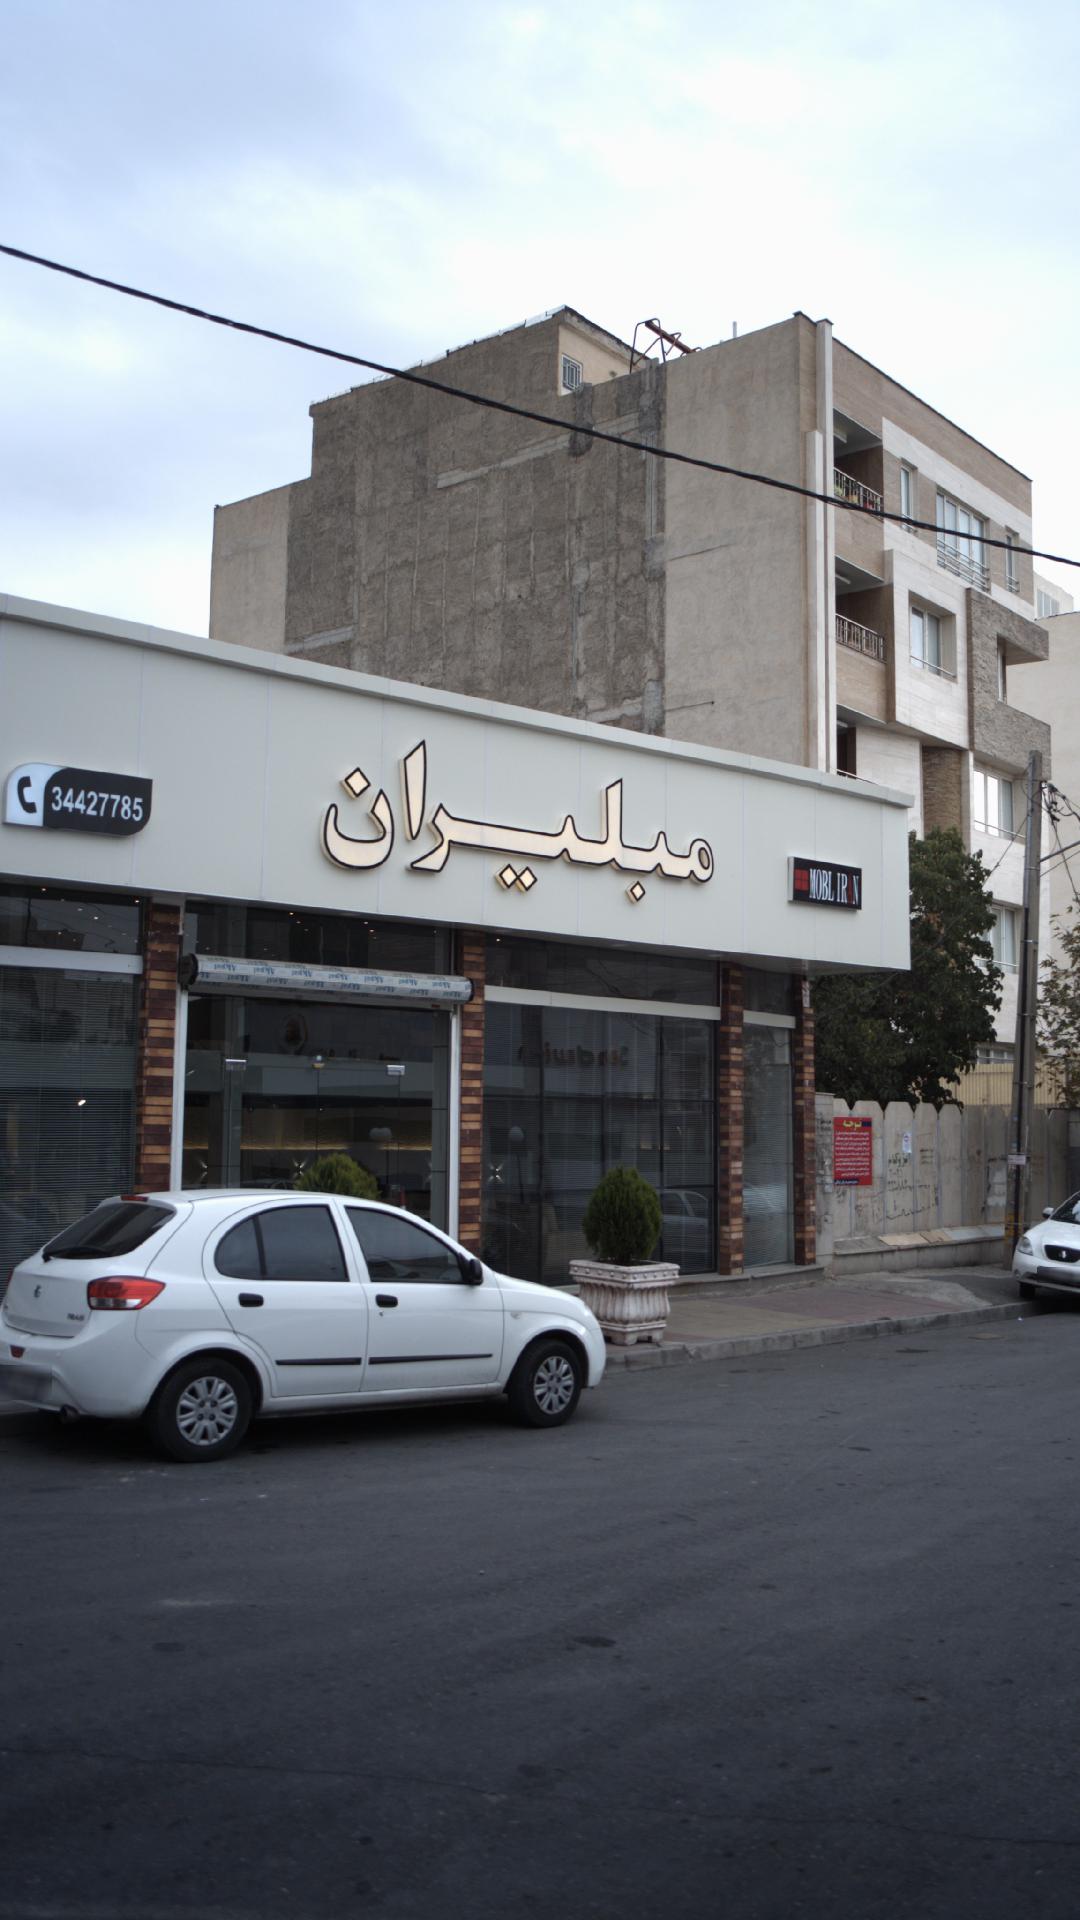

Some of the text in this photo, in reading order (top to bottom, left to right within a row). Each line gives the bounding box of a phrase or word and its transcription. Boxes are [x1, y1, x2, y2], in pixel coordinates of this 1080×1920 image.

[51, 786, 144, 822] 34427785
[809, 868, 859, 905] MOBL IRAN
